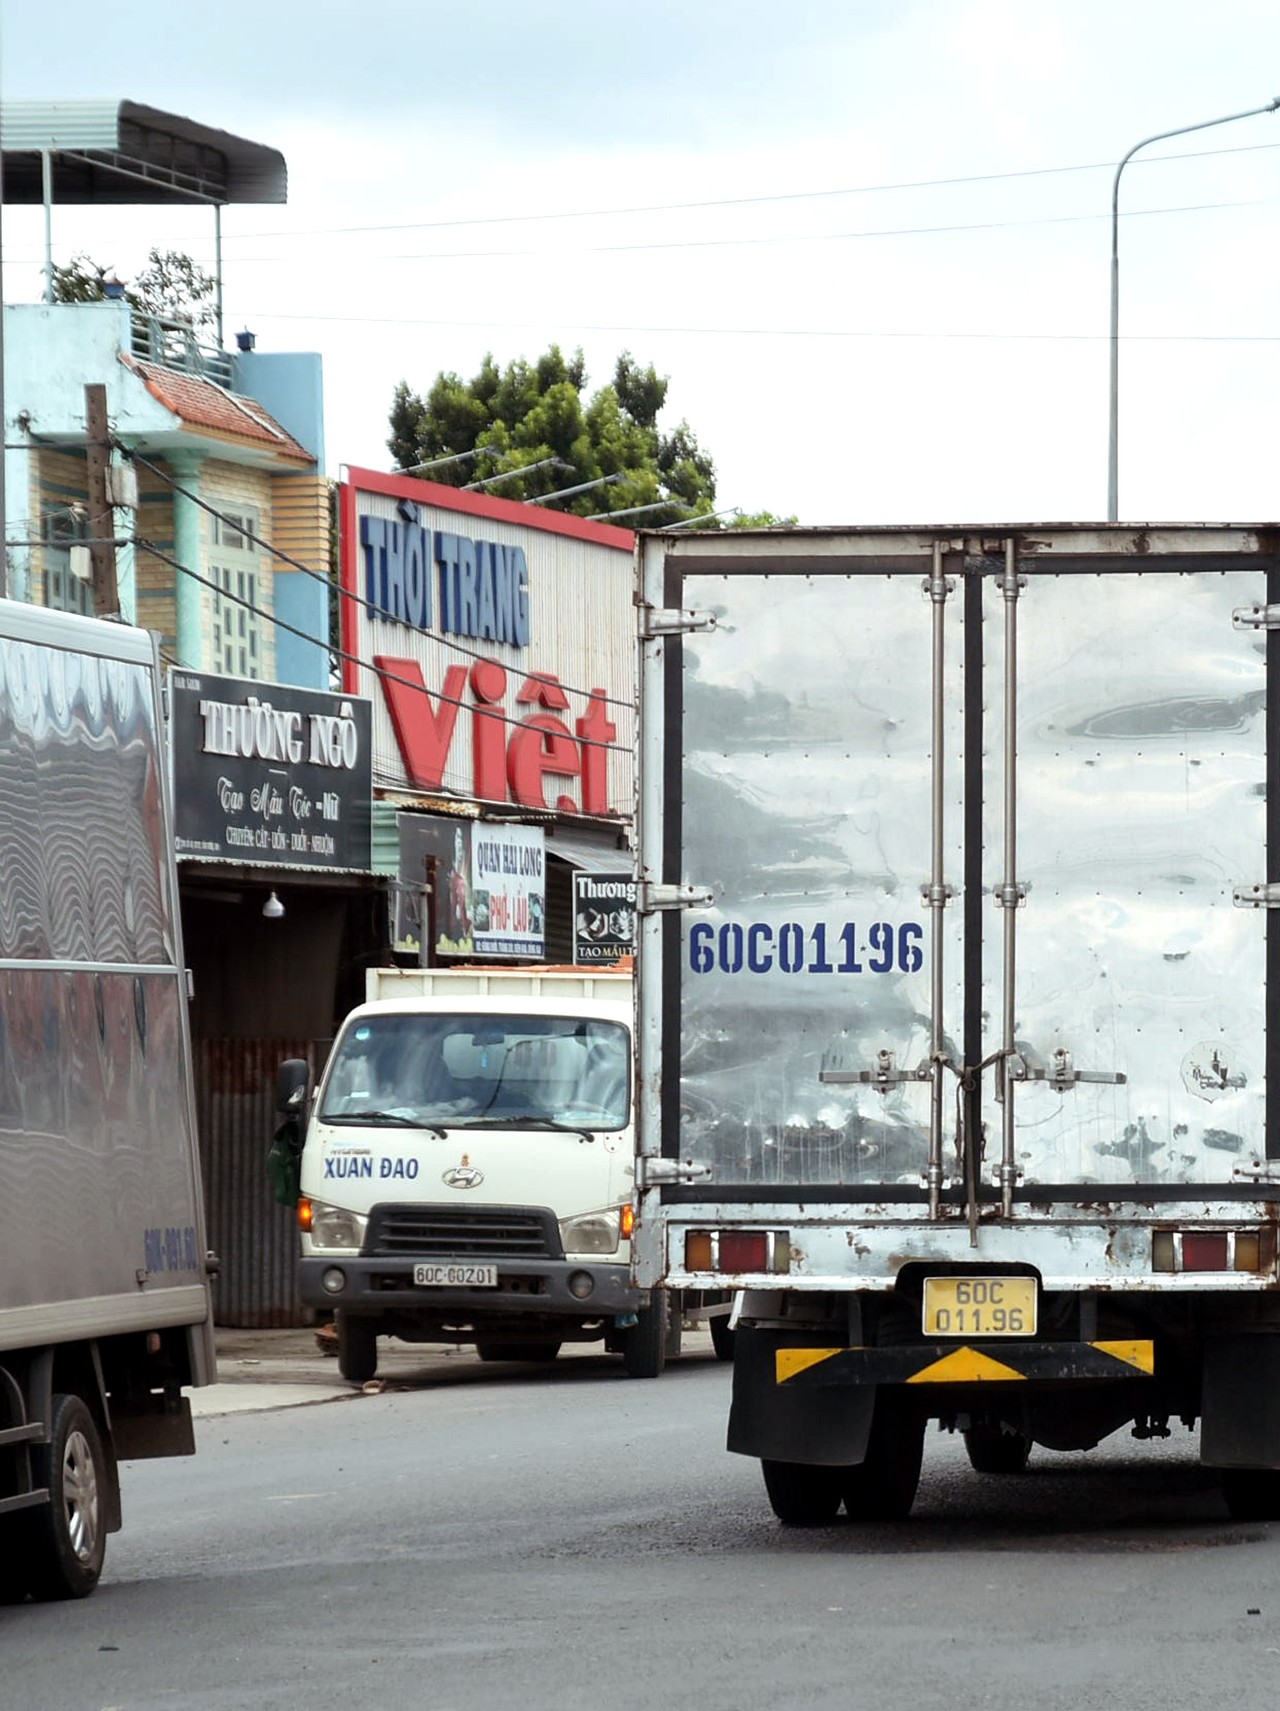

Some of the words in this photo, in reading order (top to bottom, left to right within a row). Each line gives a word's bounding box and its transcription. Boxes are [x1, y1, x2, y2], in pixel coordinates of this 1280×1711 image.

[360, 498, 432, 628] THỜI
[434, 530, 529, 649] TRANG
[308, 701, 358, 769] NGÔ
[373, 656, 616, 816] Việt
[217, 776, 245, 814] Tạo
[520, 846, 541, 878] LONG
[577, 877, 636, 902] Thương
[324, 1157, 372, 1179] XUAN
[380, 1158, 419, 1179] ĐAO
[956, 1281, 1003, 1304] 60C
[936, 1308, 1023, 1332] 011.96
